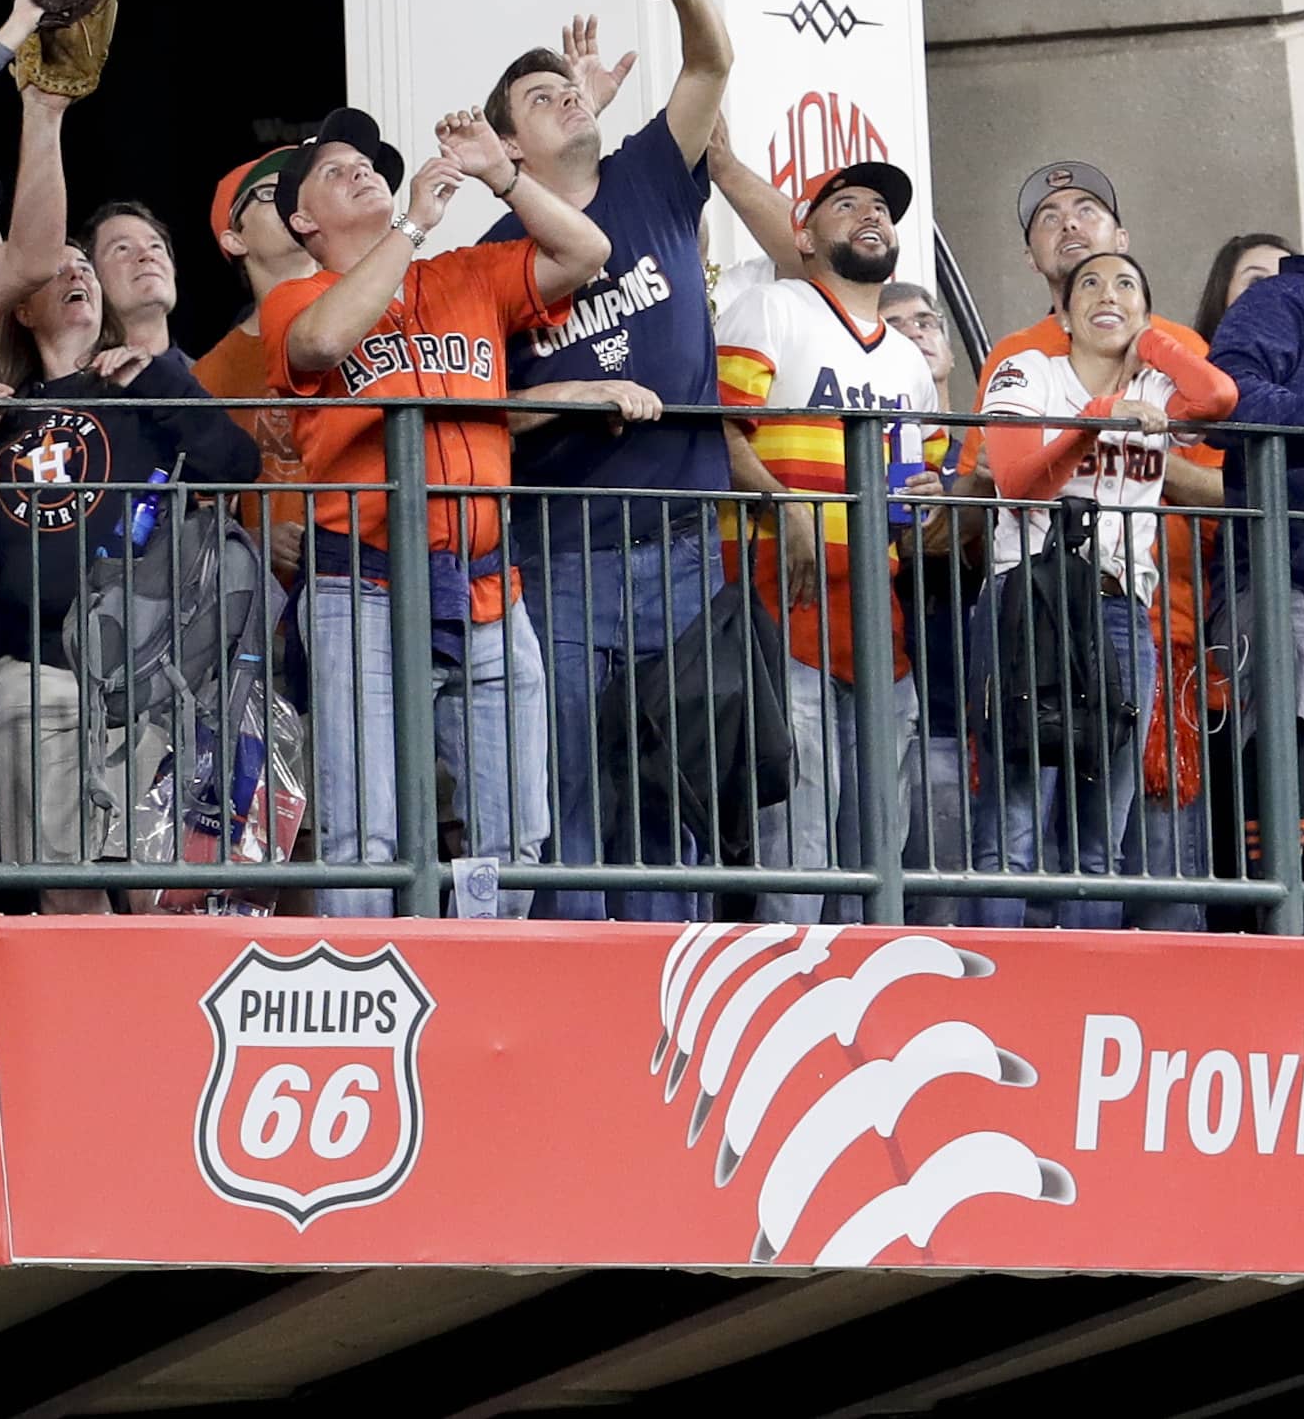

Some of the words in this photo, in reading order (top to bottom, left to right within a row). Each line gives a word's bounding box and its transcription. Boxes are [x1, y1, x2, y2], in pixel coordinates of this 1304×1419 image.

[339, 331, 495, 397] ASTROS
[240, 990, 398, 1035] PHILLIPS
[240, 1063, 379, 1161] 66
